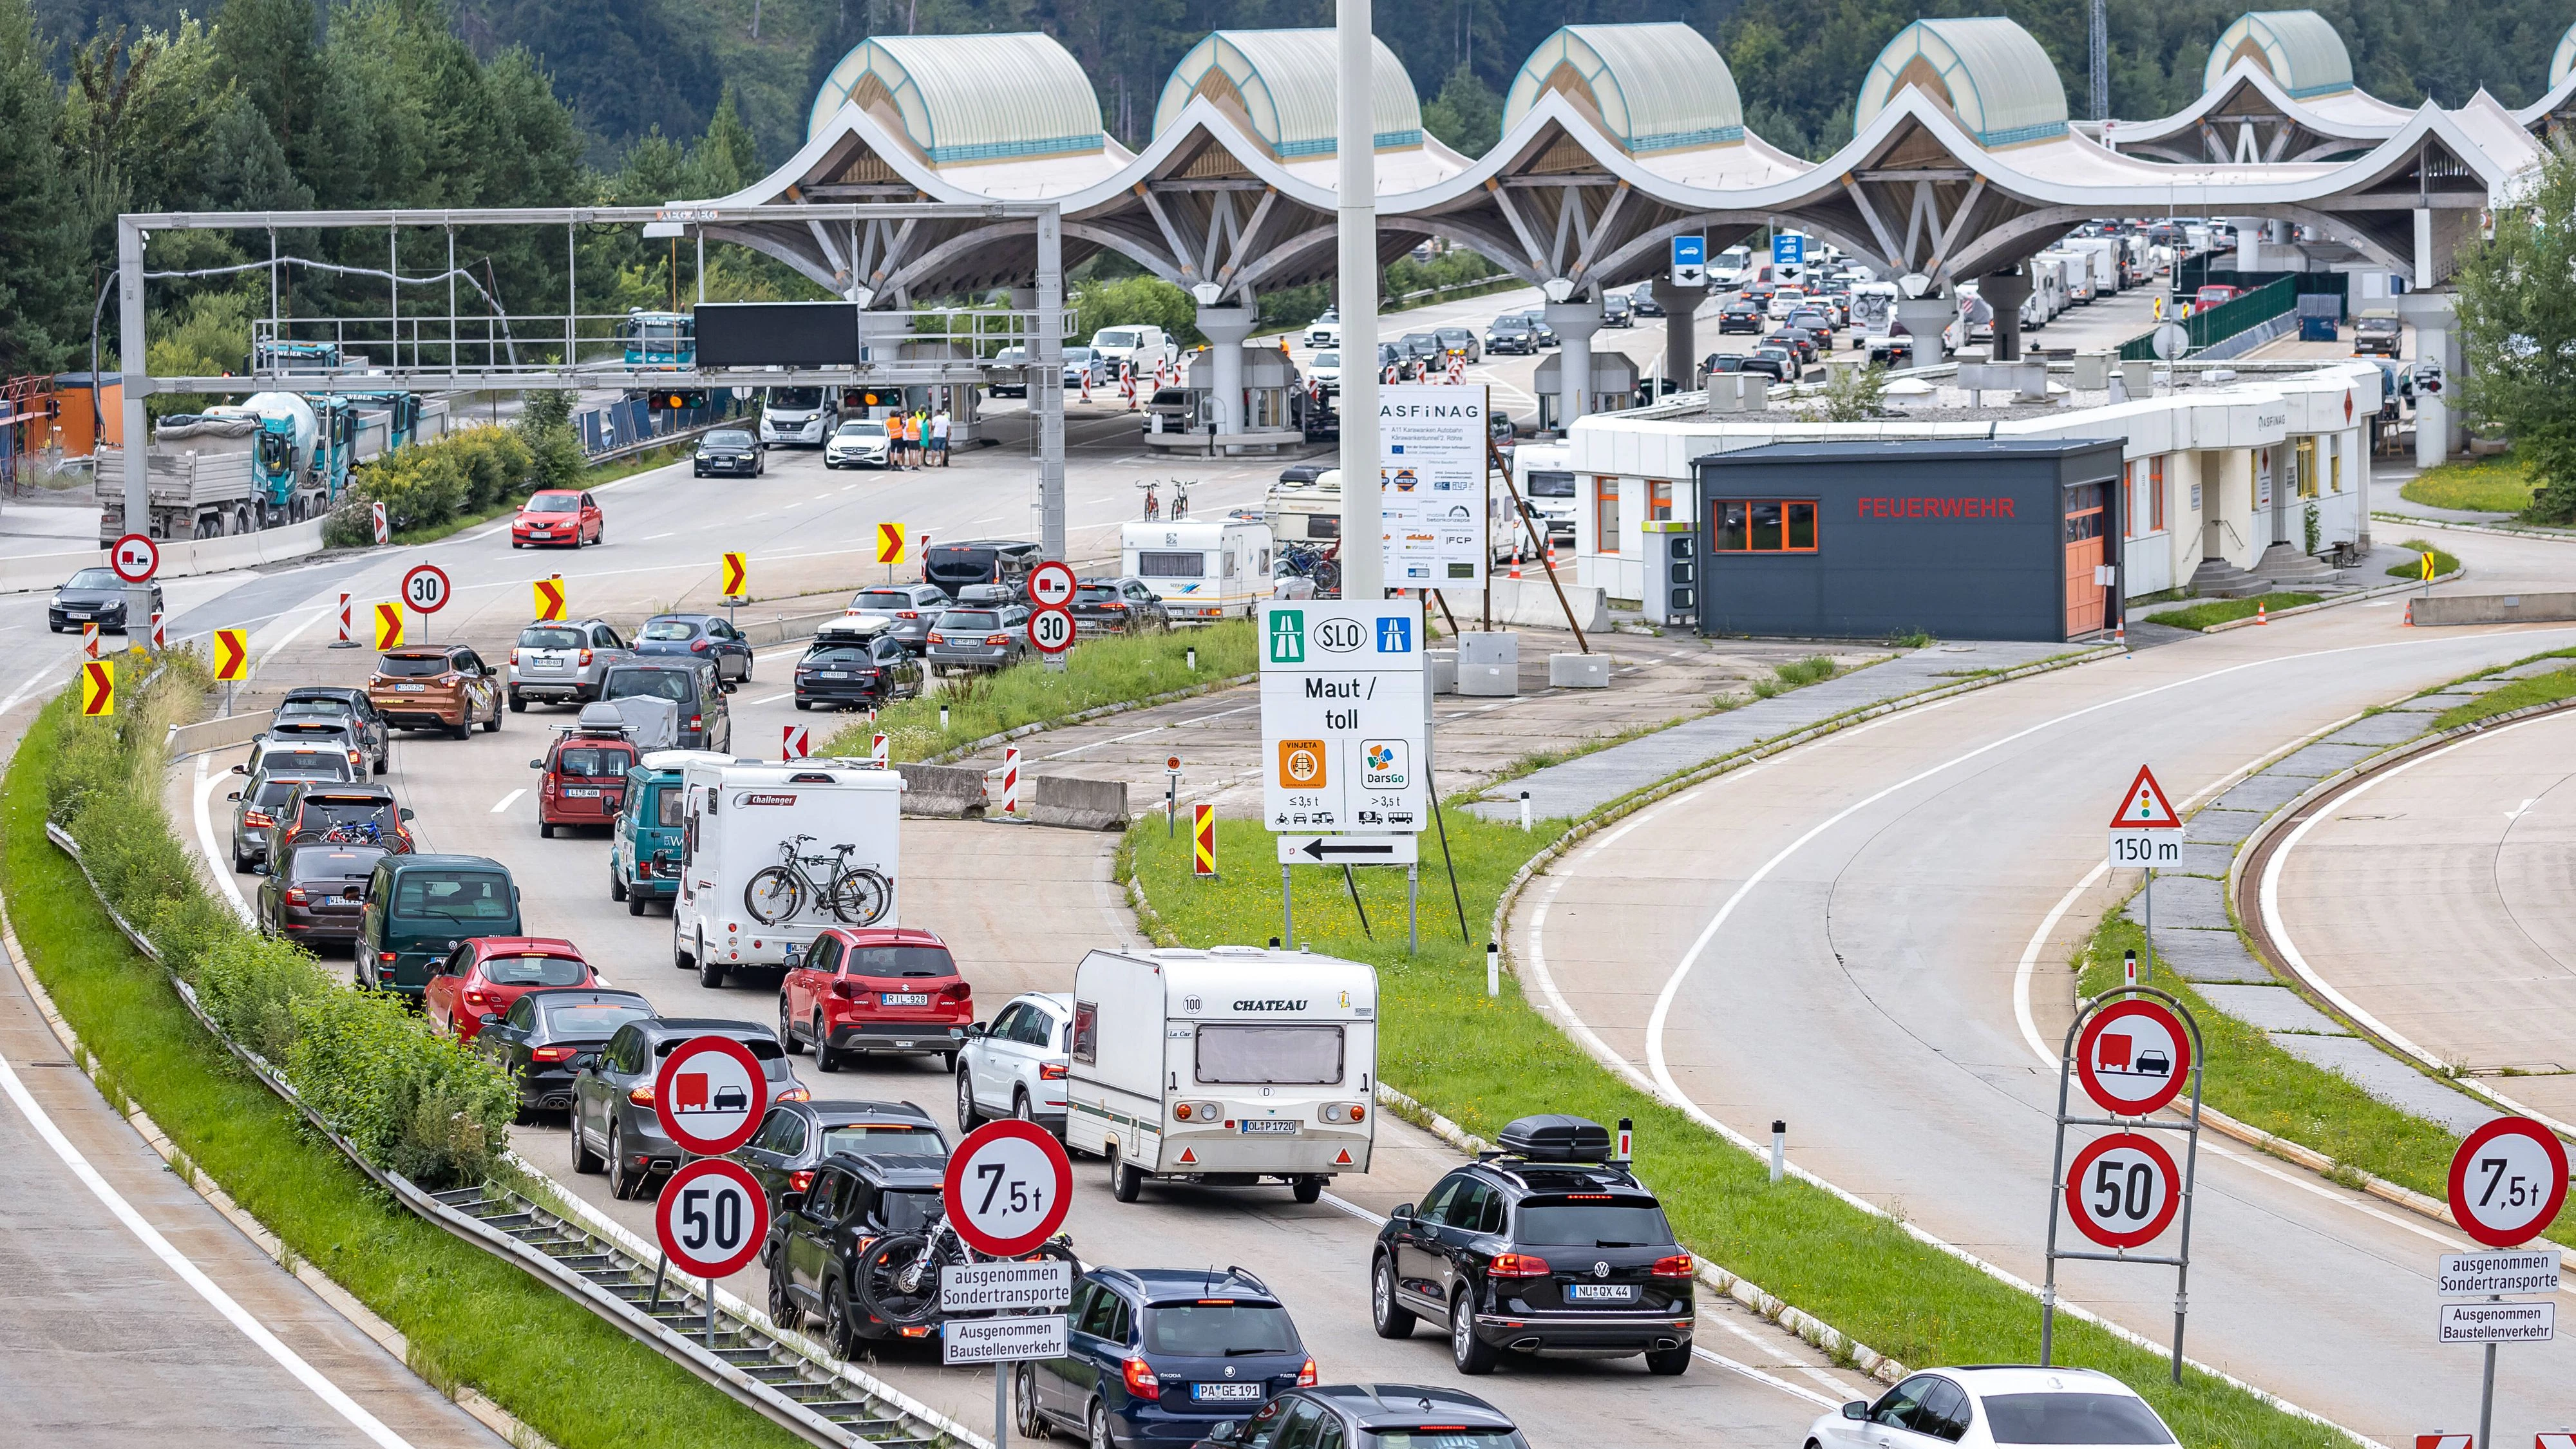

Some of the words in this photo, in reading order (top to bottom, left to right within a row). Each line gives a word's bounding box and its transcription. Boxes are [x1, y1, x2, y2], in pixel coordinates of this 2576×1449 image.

[1857, 497, 2015, 518] FEUERWEHR
[413, 578, 437, 601] 30
[1040, 617, 1063, 641] 30
[1322, 625, 1359, 647] SLO
[1305, 677, 1360, 698] Maut
[1367, 676, 1377, 700] /
[1325, 709, 1358, 729] toll
[1367, 773, 1405, 783] DarsGo
[752, 795, 793, 806] Challenger
[2115, 838, 2152, 860] 150
[2159, 844, 2178, 860] m
[1185, 999, 1200, 1010] 100
[1233, 999, 1309, 1011] CHATEAU
[1264, 1088, 1270, 1096] D
[1249, 1122, 1260, 1131] OL
[1265, 1122, 1271, 1131] P
[1273, 1122, 1294, 1131] 1720
[2094, 1160, 2153, 1220] 50
[682, 1188, 741, 1250] 50
[2452, 1256, 2548, 1274] ausgenommen
[955, 1268, 1058, 1287] ausgenommen
[2440, 1273, 2558, 1291] Sondertransporte
[943, 1286, 1069, 1305] Sondertransporte
[1578, 1285, 1593, 1297] NU
[1599, 1286, 1613, 1297] QX
[1615, 1286, 1628, 1298] 44
[2453, 1308, 2541, 1323] Ausgenommen
[959, 1323, 1051, 1340] Ausgenommen
[2443, 1325, 2550, 1339] Baustellenverkehr
[950, 1340, 1061, 1358] Baustellenverkehr
[1200, 1385, 1215, 1396] PA
[1223, 1385, 1237, 1396] GE
[1239, 1385, 1259, 1396] 191
